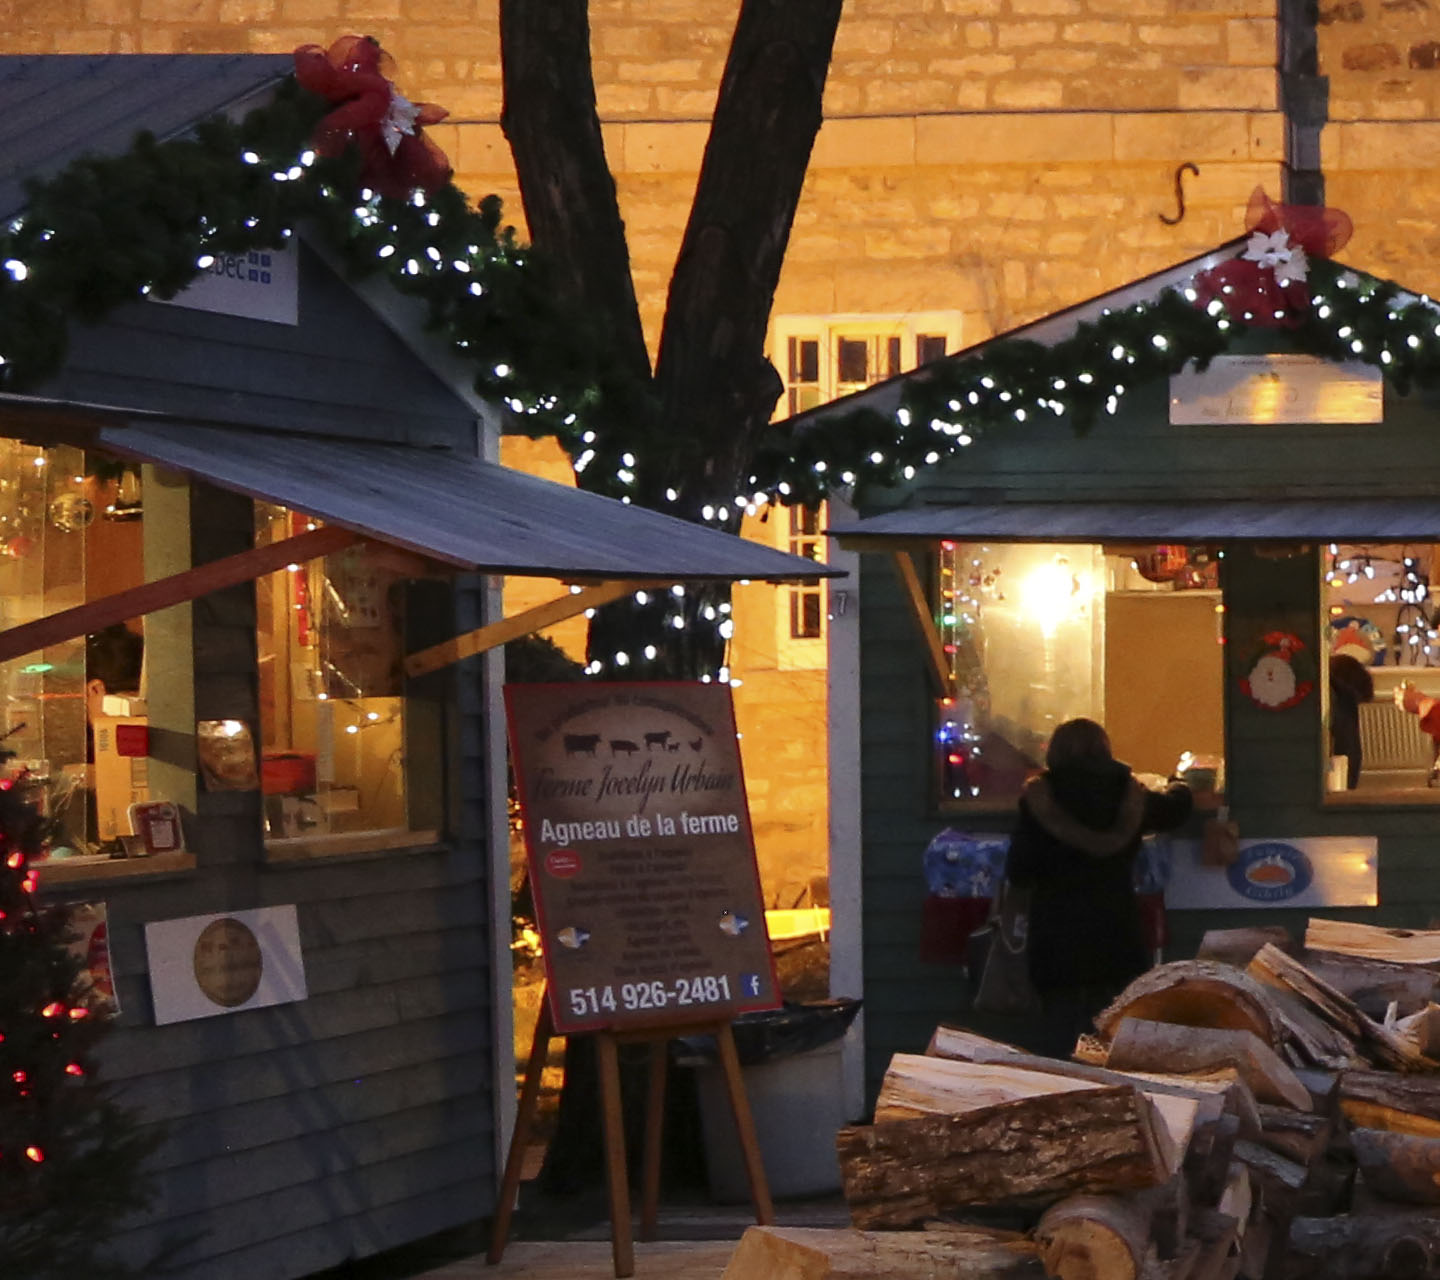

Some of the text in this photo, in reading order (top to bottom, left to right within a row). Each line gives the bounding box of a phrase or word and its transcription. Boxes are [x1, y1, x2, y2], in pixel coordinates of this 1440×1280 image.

[540, 811, 740, 848] Agneau de la ferme
[570, 974, 733, 1017] 514 926-2481
